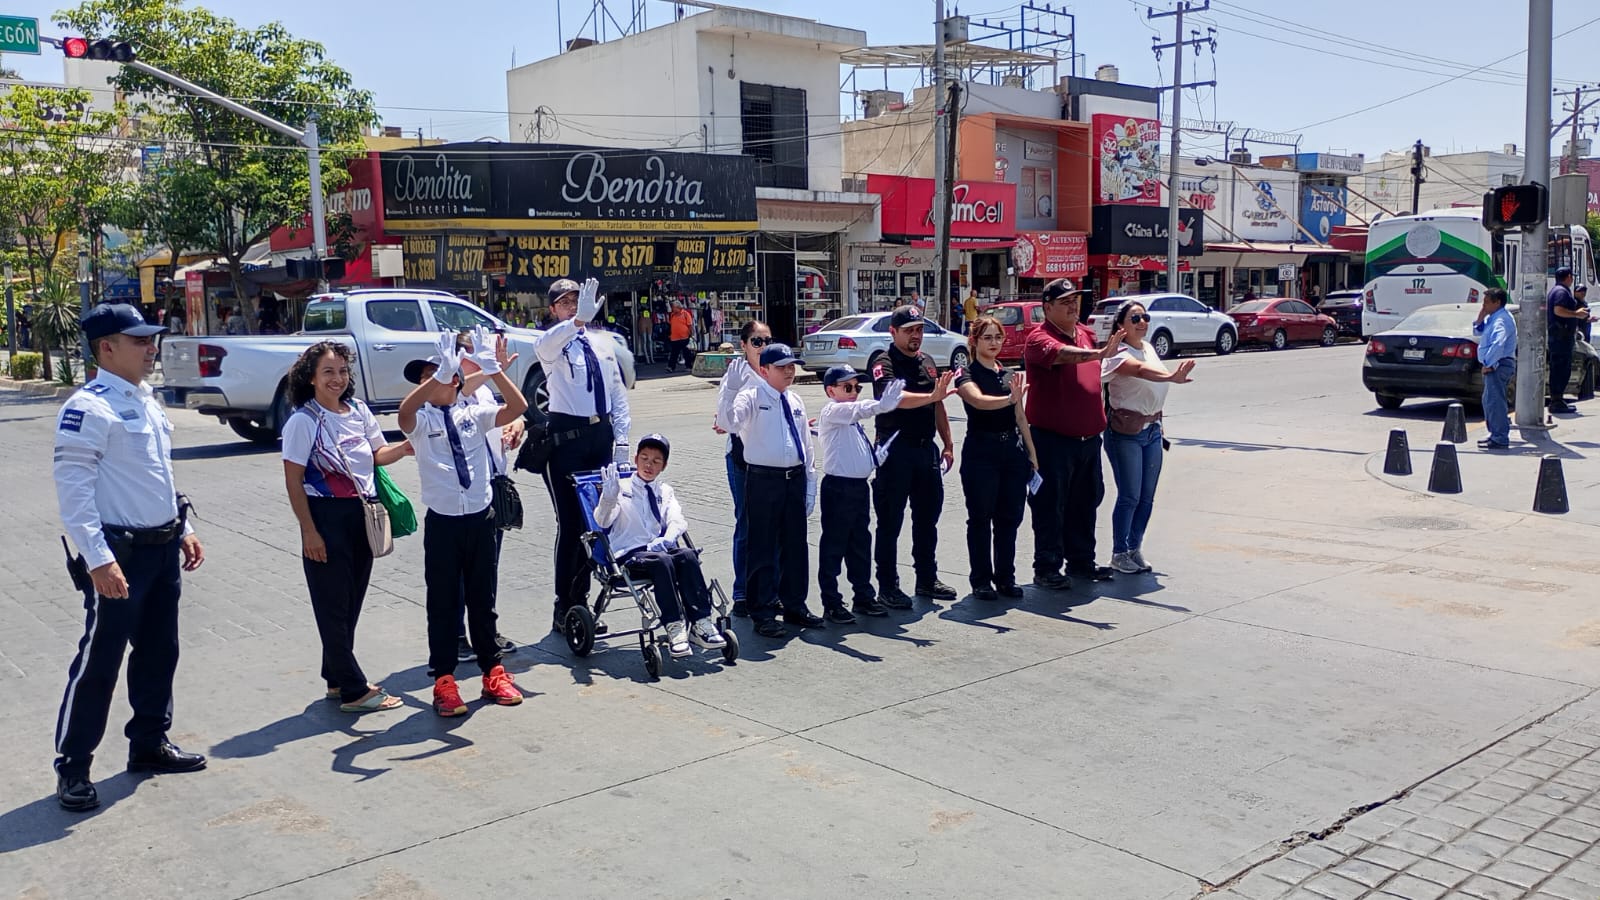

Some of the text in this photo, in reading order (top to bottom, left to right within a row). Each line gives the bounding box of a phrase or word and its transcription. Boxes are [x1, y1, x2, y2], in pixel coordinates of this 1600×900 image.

[394, 153, 473, 201] Bendita
[561, 152, 705, 205] Bendita
[409, 203, 458, 215] Lenceria
[597, 205, 675, 218] Lenceria
[1124, 223, 1152, 238] China
[447, 250, 453, 271] 3
[462, 248, 485, 272] $170
[532, 253, 570, 279] $130
[593, 246, 603, 267] 3
[621, 244, 654, 268] $170
[683, 256, 704, 275] $130
[713, 249, 719, 267] 3
[727, 248, 747, 268] $170
[404, 259, 410, 280] 3
[1411, 278, 1426, 289] 172
